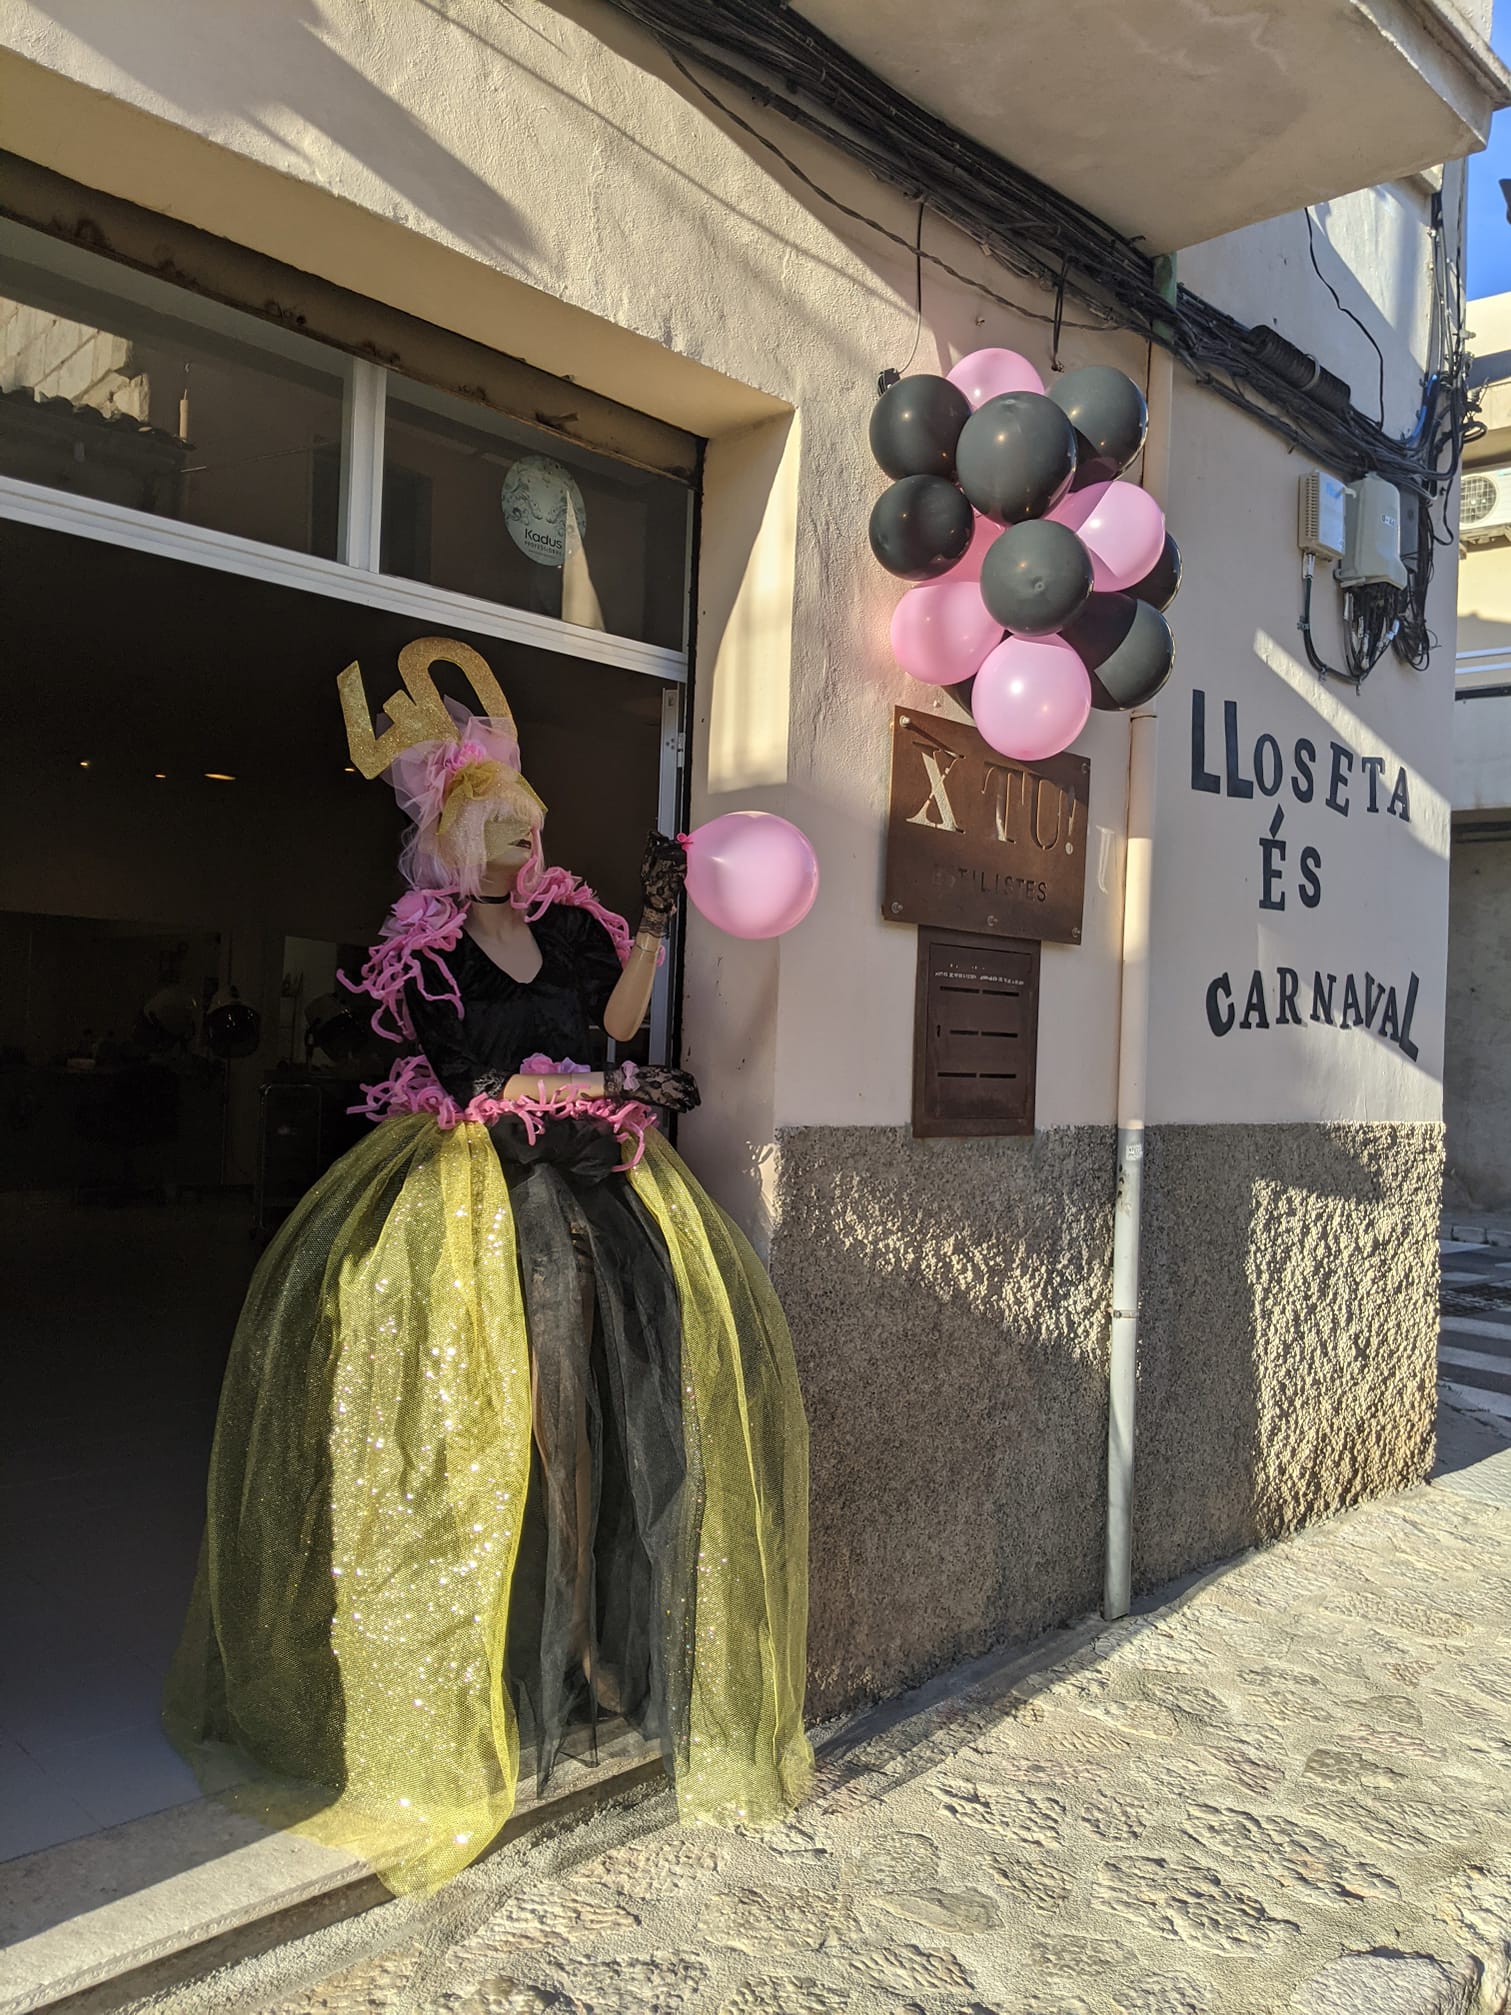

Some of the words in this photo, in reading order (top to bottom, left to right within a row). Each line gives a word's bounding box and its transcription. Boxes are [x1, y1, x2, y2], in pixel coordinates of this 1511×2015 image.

[525, 528, 562, 549] Kadus
[905, 742, 966, 834] X
[1191, 689, 1411, 822] LLOSETA
[1259, 803, 1322, 911] ÉS
[1206, 967, 1420, 1062] CARNAVAL
